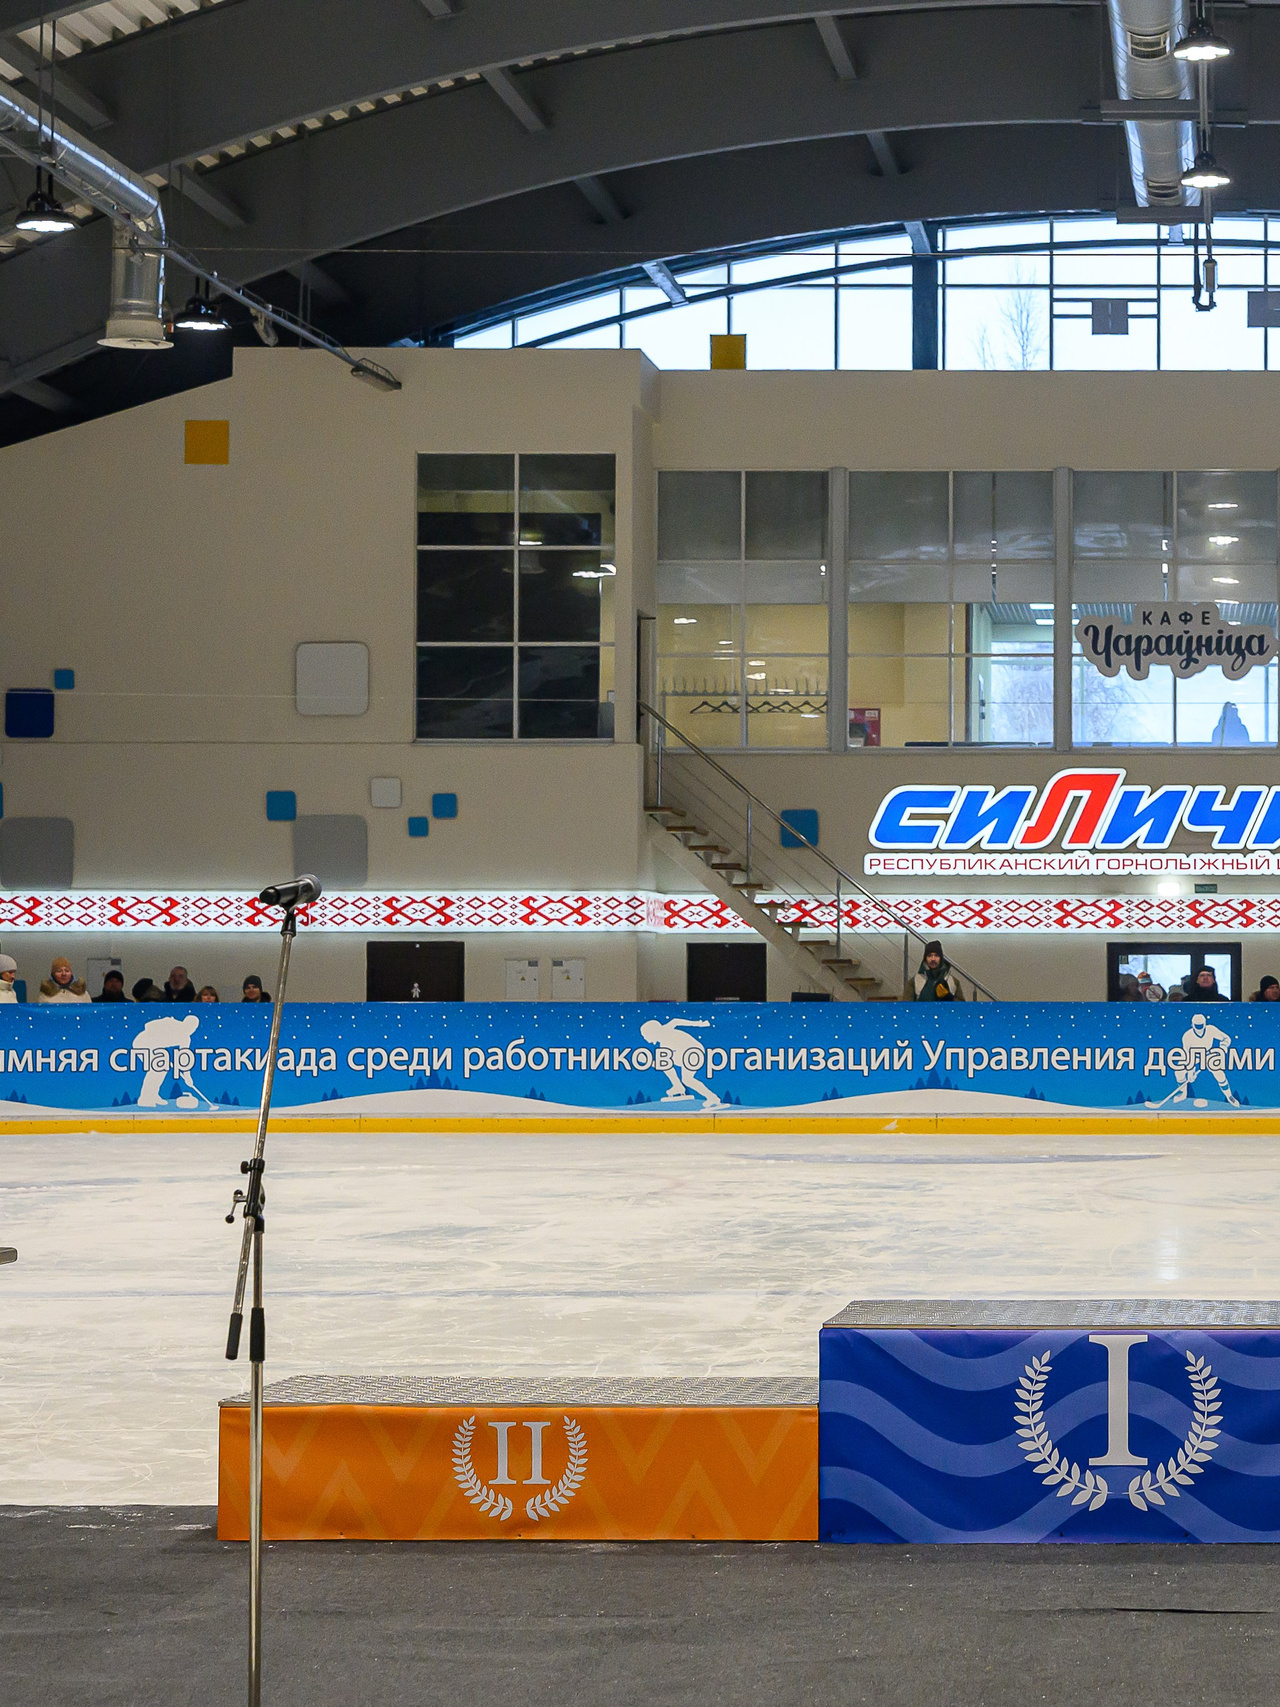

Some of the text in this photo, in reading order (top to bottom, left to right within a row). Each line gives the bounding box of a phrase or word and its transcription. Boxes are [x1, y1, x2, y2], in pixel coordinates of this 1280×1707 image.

[1142, 610, 1211, 626] КАФЕ
[1083, 624, 1270, 672] Чараўніца
[869, 855, 1090, 871] РЕСПУБЛИКАНСКИЙ
[1095, 855, 1270, 871] ГОРНОЛЫЖНЫЙ
[0, 1048, 99, 1073] мняя
[108, 1048, 337, 1080] спартакиада
[346, 1047, 453, 1079] среди
[463, 1038, 675, 1079] работников
[682, 1040, 914, 1079] организаций
[920, 1040, 1136, 1079] Управления
[1143, 1047, 1275, 1077] делами
[487, 1421, 552, 1485] II
